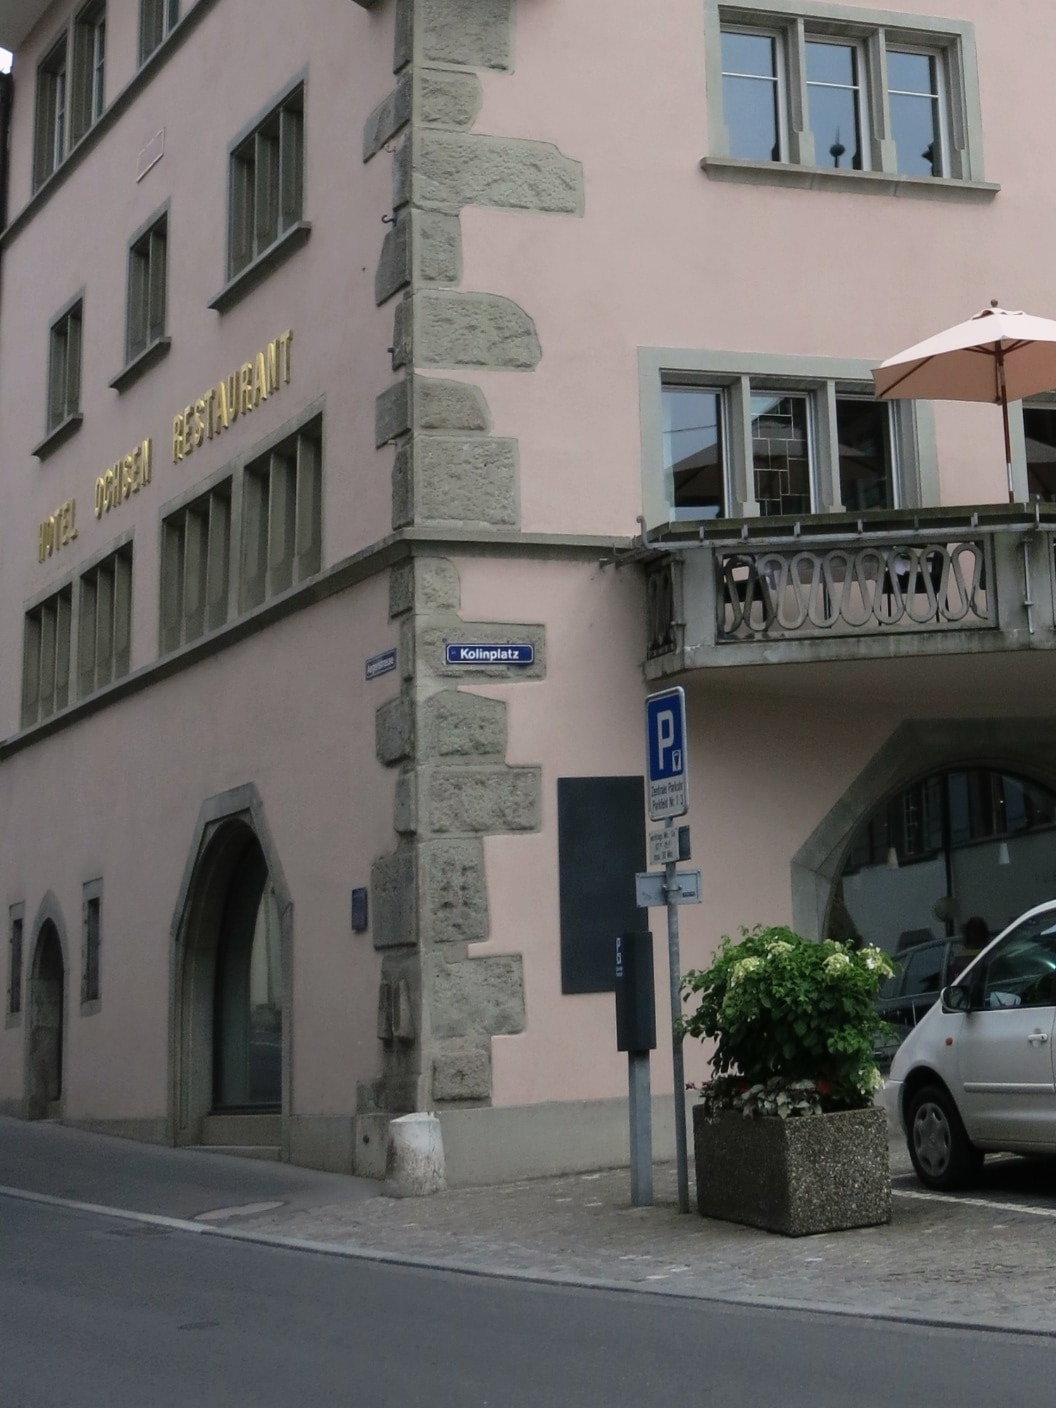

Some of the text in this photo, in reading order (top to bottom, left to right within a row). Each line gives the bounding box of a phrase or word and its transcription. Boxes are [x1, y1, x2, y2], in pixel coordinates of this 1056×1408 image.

[39, 329, 293, 563] HOTEL OCHSEN RESTAURANT
[460, 648, 520, 661] Kolinplatz
[657, 709, 675, 771] P
